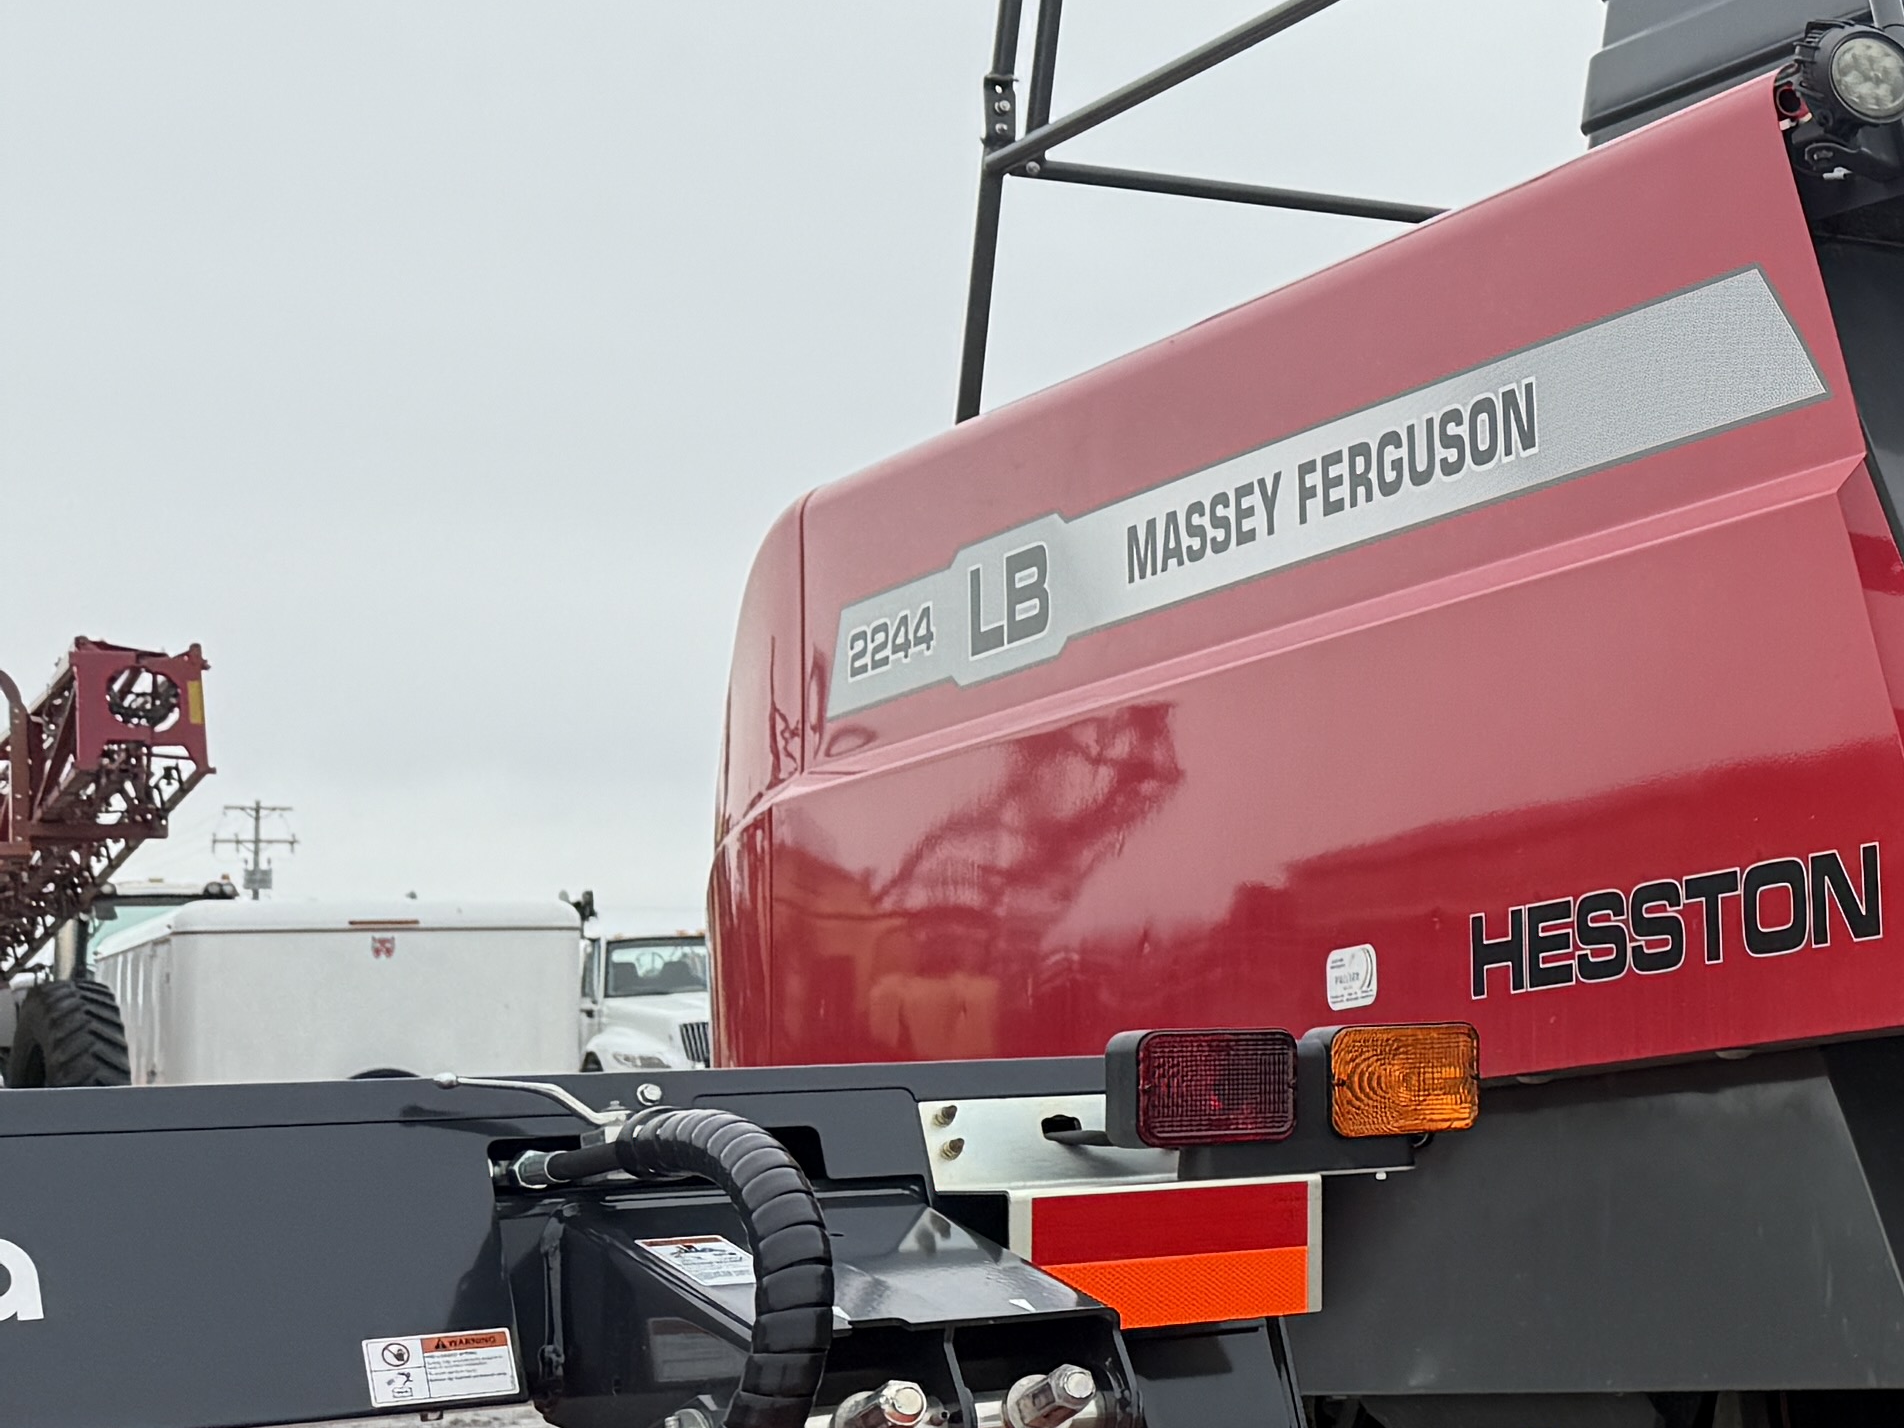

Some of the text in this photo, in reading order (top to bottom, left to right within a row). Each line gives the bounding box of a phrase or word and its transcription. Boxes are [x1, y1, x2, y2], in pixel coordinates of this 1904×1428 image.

[1127, 381, 1537, 584] MASSEY FERGUSON
[848, 543, 1050, 680] 2244 LB
[1470, 842, 1883, 1000] HESSTON
